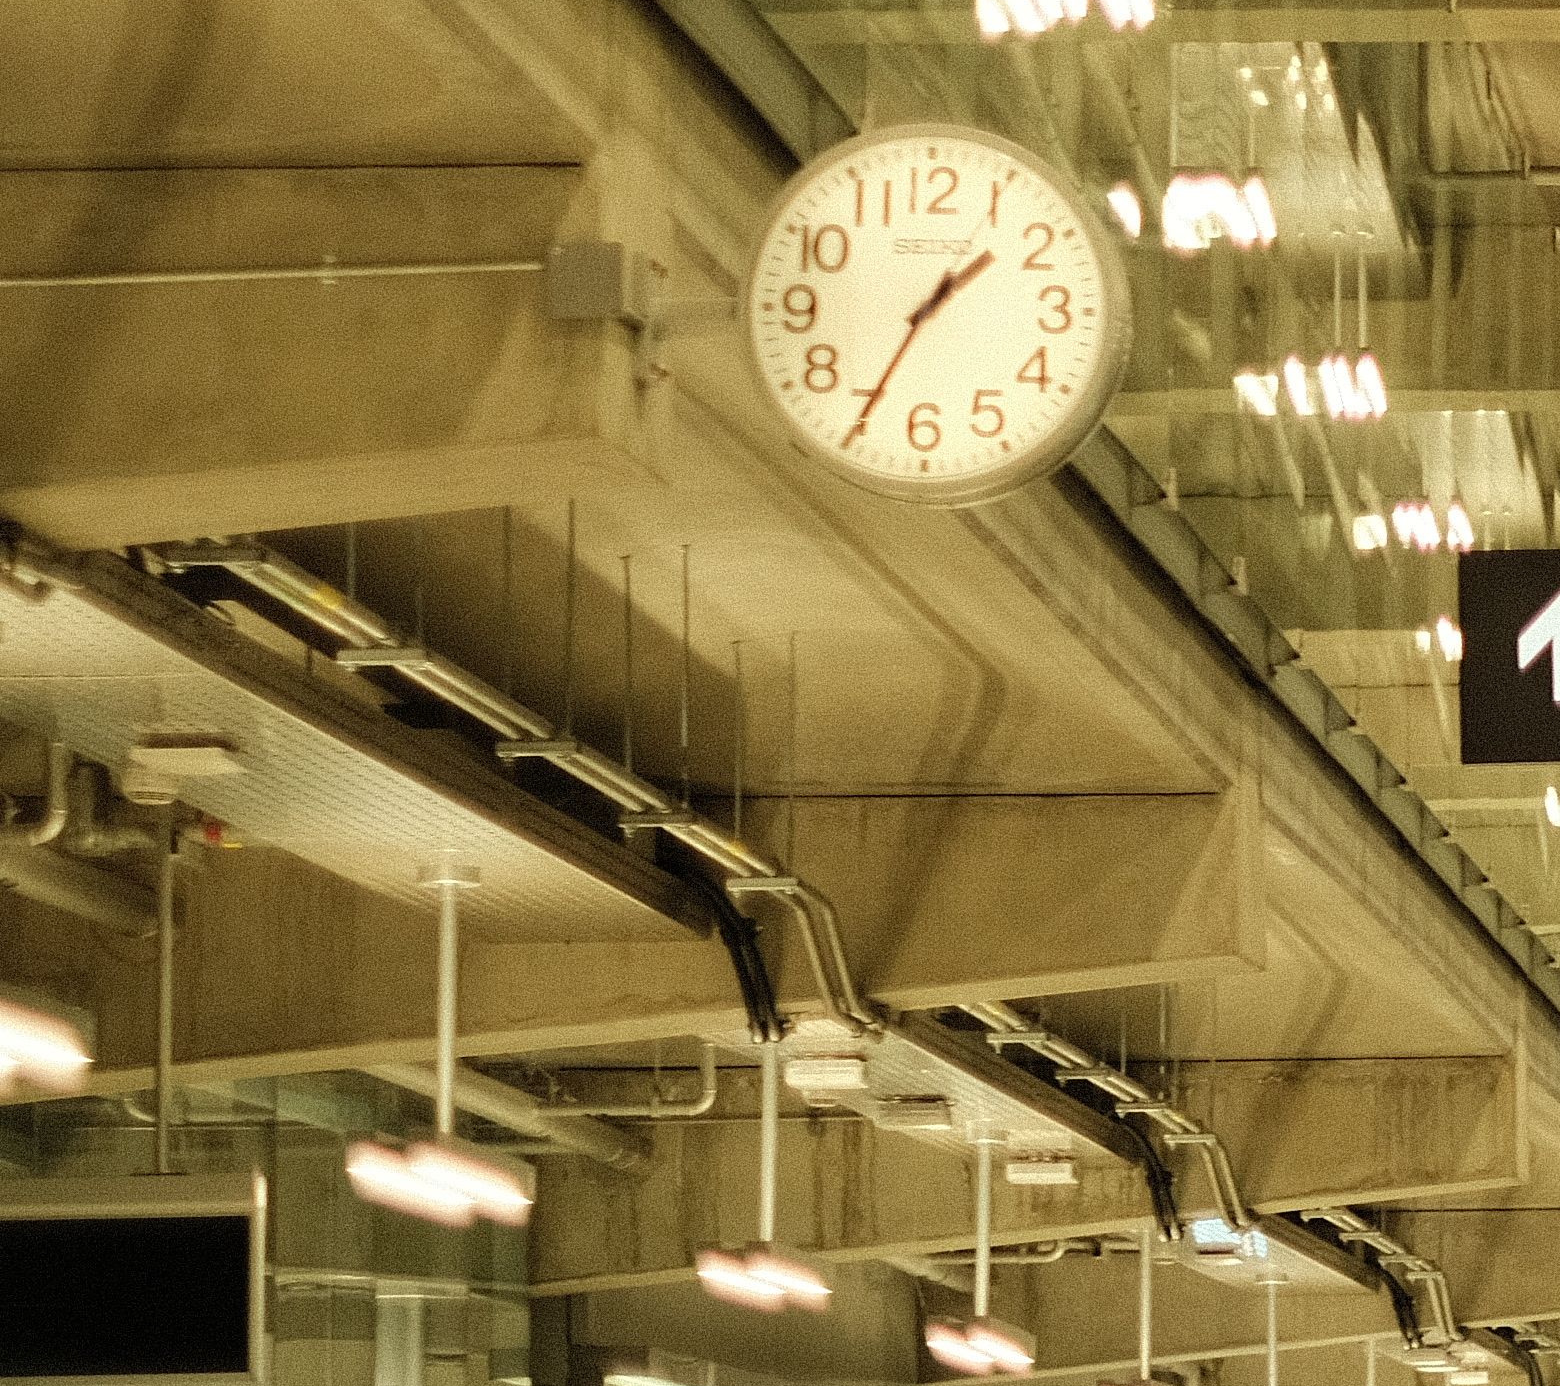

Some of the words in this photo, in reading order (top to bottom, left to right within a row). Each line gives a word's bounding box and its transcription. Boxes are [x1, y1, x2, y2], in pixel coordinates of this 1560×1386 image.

[856, 180, 891, 226] 11
[910, 166, 959, 214] 12
[990, 180, 999, 227] 1
[801, 224, 850, 273] 10
[1021, 222, 1055, 271] 2
[783, 284, 816, 333] 9
[1038, 285, 1072, 333] 3
[805, 344, 838, 393] 8
[1016, 346, 1051, 392] 4
[908, 403, 941, 452] 6
[972, 389, 1004, 438] 5
